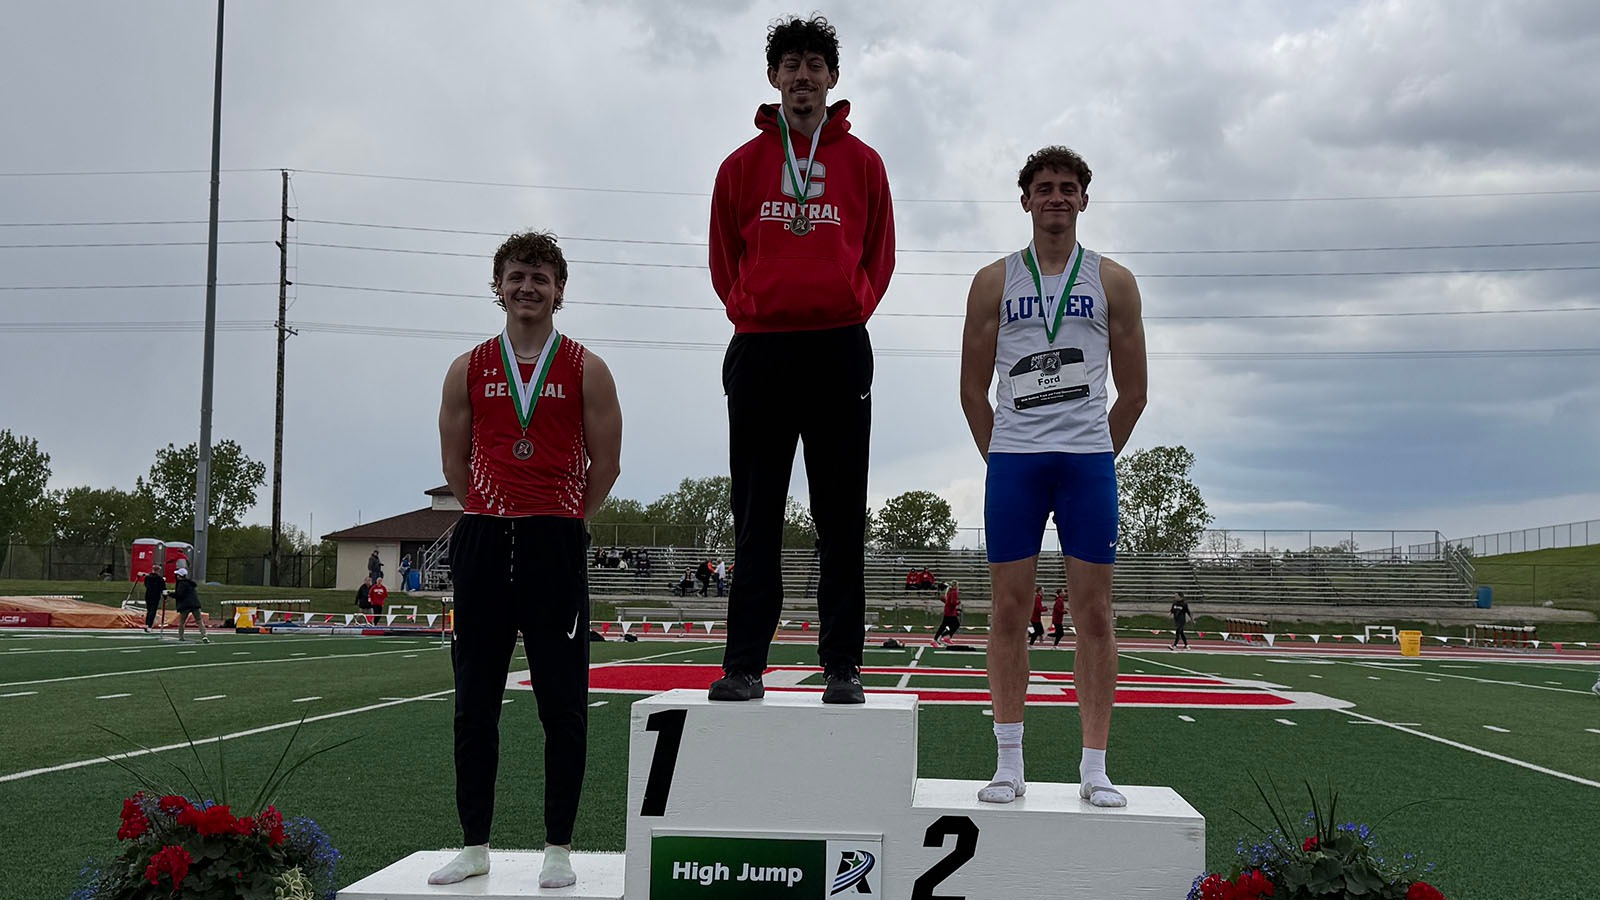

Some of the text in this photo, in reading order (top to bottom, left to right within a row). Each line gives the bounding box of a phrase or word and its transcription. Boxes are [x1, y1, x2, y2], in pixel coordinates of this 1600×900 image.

[781, 158, 826, 200] C
[760, 201, 841, 221] CENTRAL
[1006, 295, 1094, 323] LUTER
[484, 383, 566, 399] CEAL
[1037, 375, 1060, 386] Ford
[640, 709, 688, 817] 1
[910, 815, 980, 900] 2
[672, 861, 803, 887] High Jump
